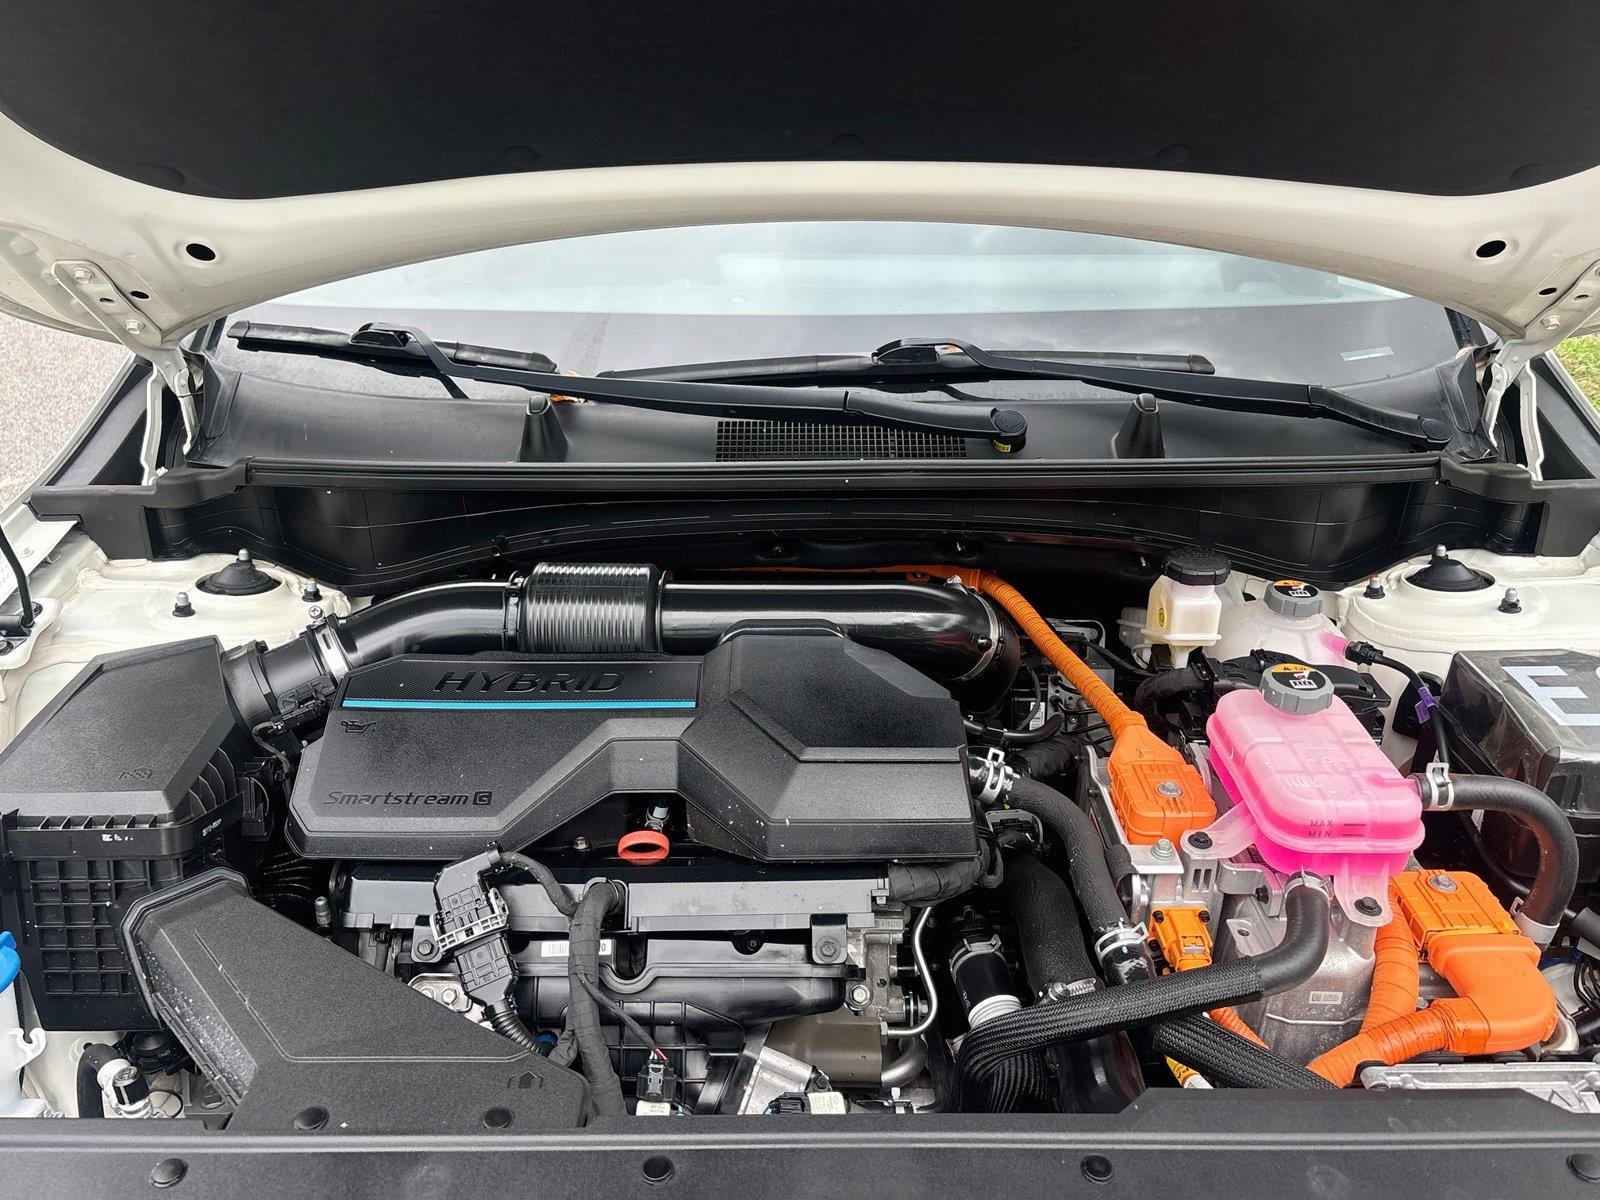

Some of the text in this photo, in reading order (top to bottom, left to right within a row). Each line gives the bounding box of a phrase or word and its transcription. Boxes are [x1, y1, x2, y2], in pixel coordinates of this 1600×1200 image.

[434, 671, 625, 692] HYBRID
[1501, 665, 1600, 726] E
[324, 791, 493, 806] Smartstream G
